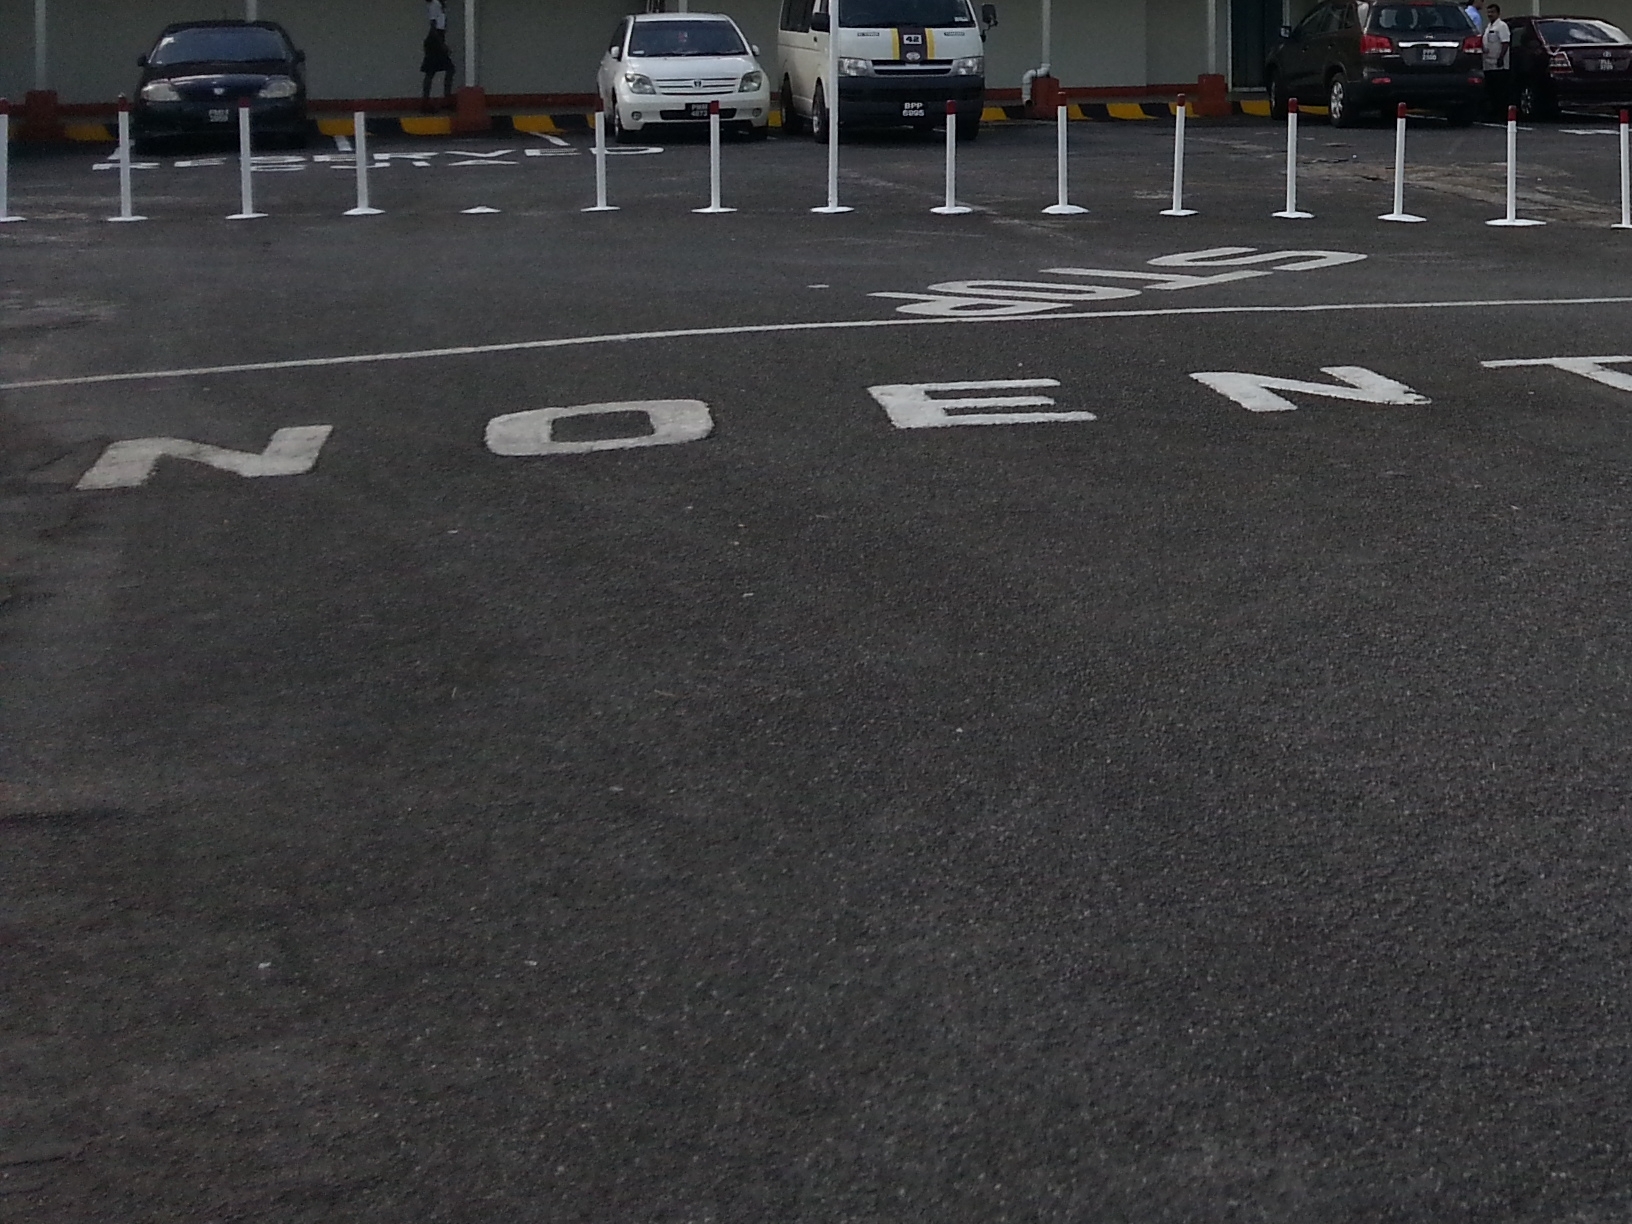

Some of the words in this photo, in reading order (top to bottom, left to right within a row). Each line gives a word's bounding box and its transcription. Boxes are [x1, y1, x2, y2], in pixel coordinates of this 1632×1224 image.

[905, 35, 920, 44] 42
[867, 247, 1368, 317] STOP
[75, 399, 716, 491] NO
